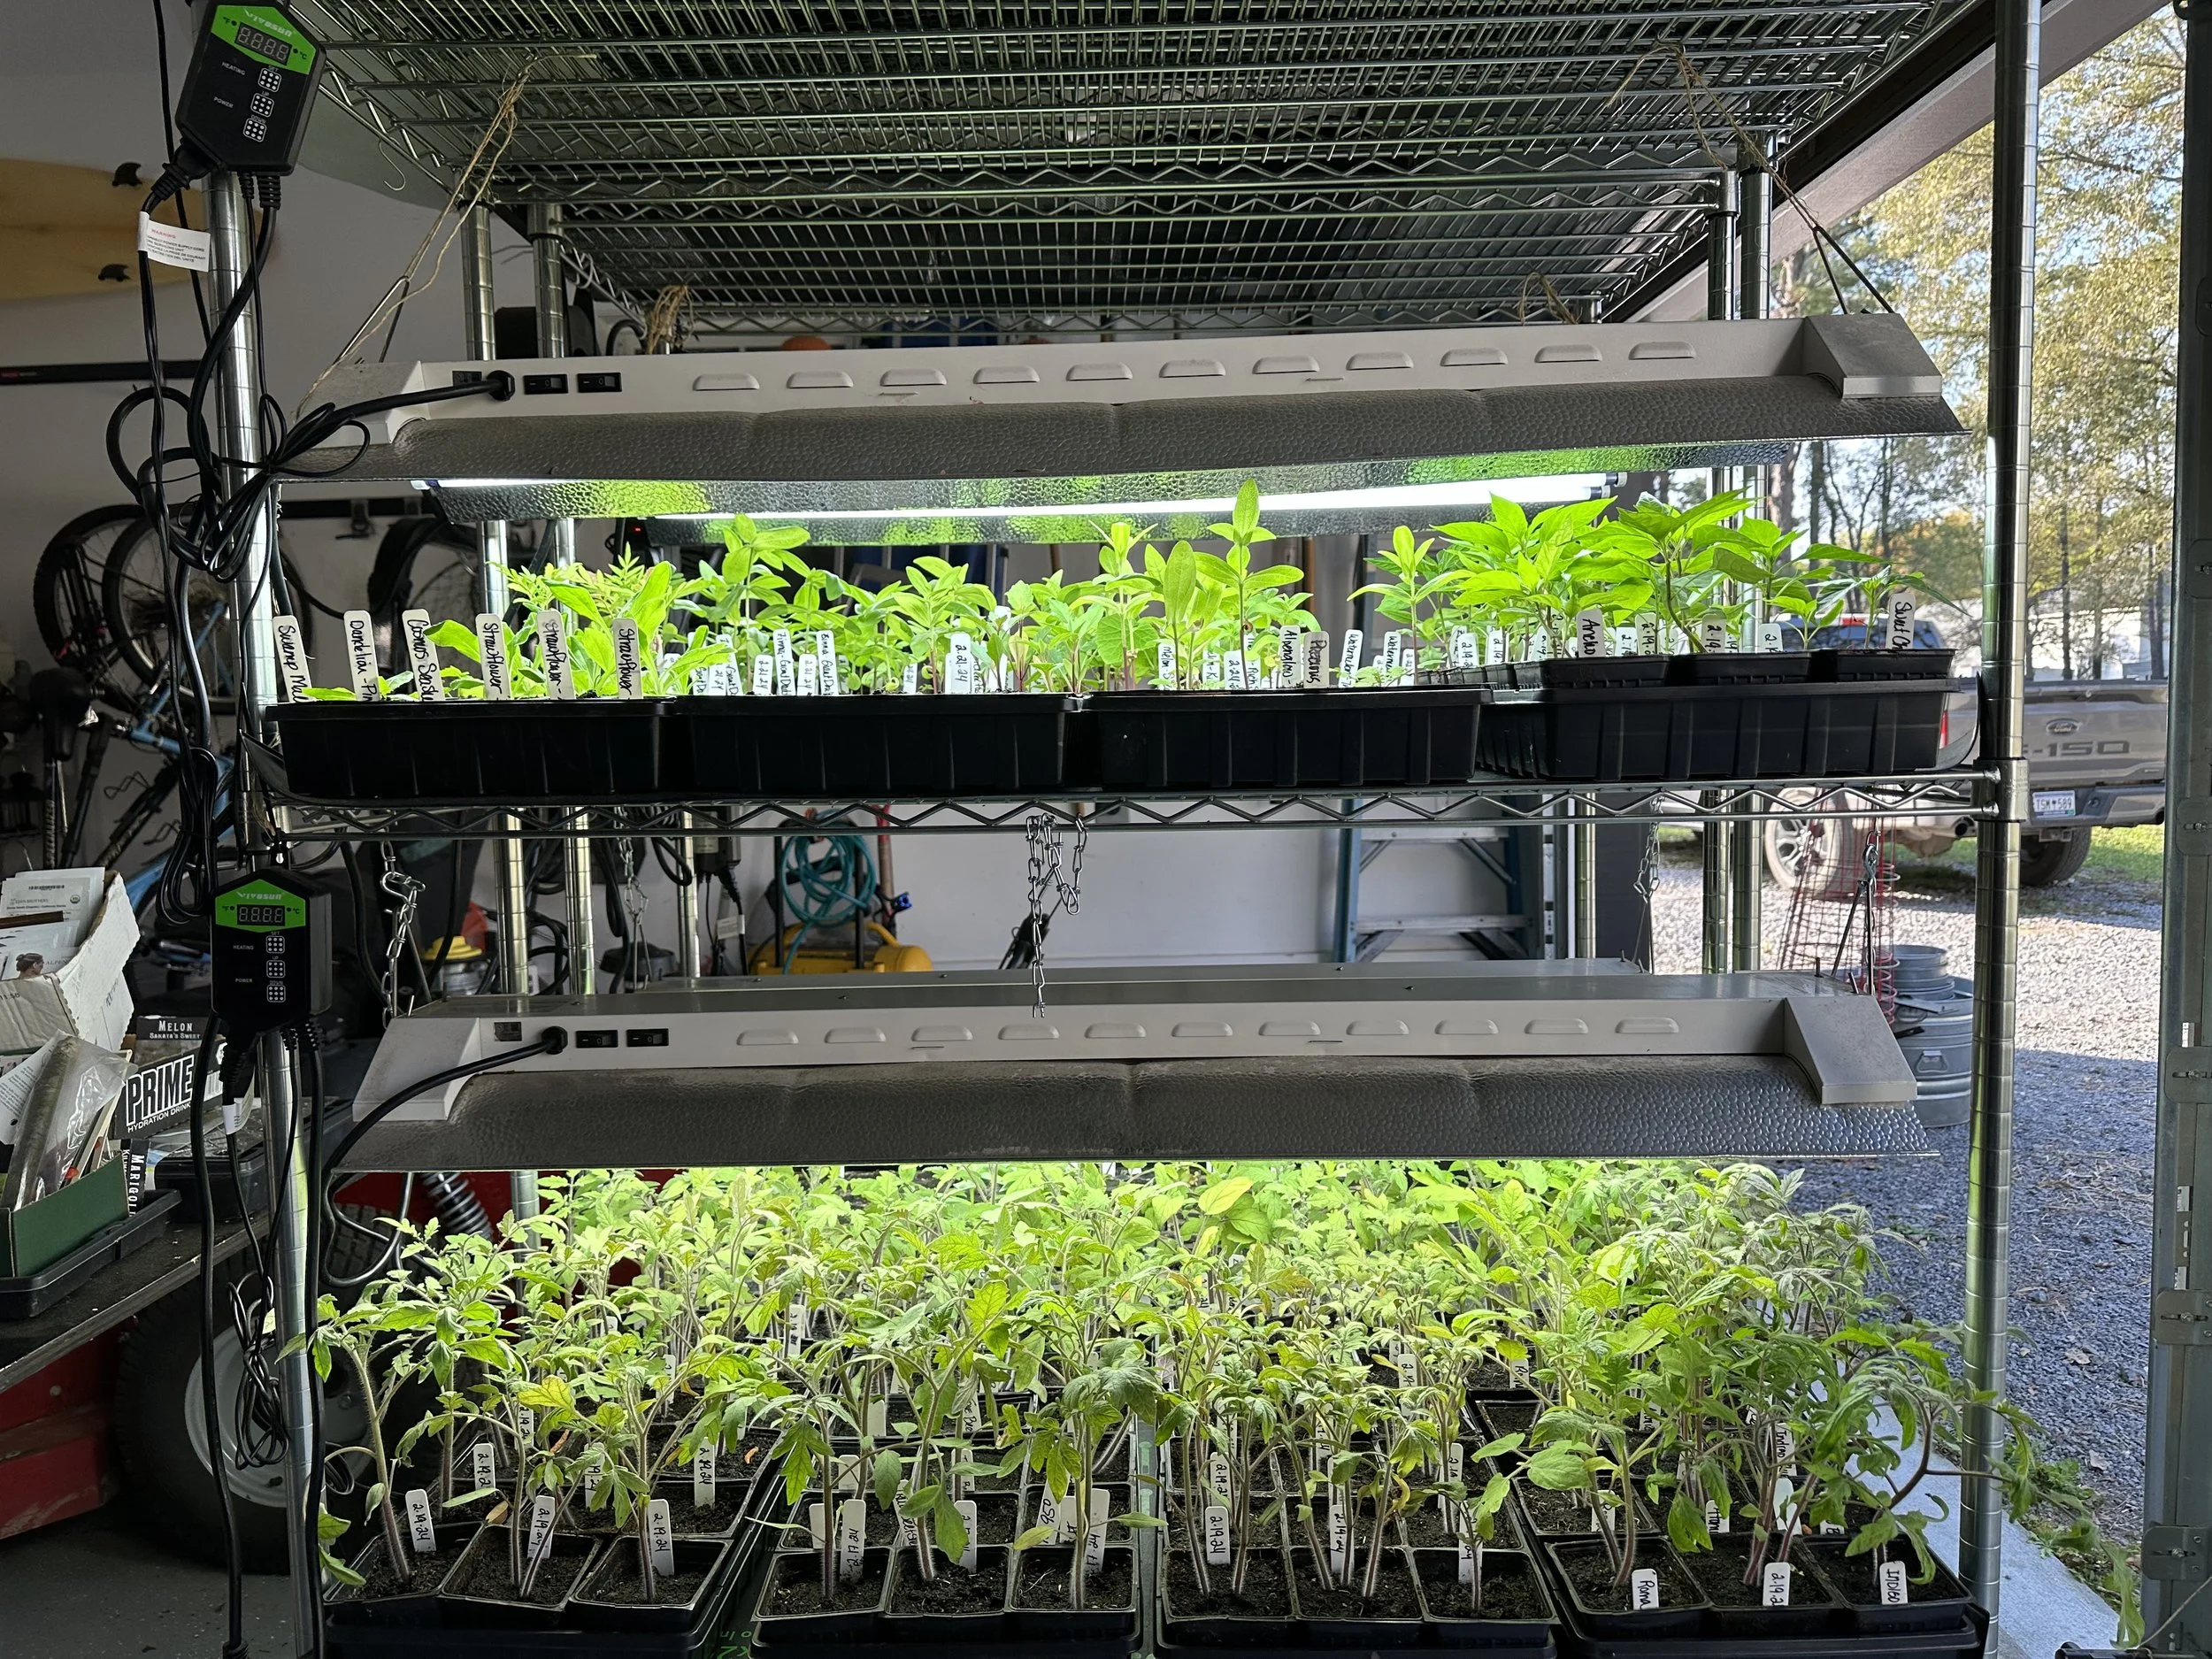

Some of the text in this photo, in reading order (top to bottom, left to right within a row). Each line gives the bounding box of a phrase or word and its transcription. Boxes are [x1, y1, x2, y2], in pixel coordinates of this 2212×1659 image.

[222, 62, 246, 76] HEATING
[213, 97, 234, 108] POWER
[482, 622, 505, 695] Strawflower
[618, 628, 638, 696] Strawflower
[158, 1020, 194, 1033] MELON
[126, 1054, 195, 1126] PRIME
[127, 1102, 192, 1133] HYDRATION DRINK
[412, 1502, 432, 1541] 2.19.24
[1210, 1515, 1227, 1555] 2.19.24
